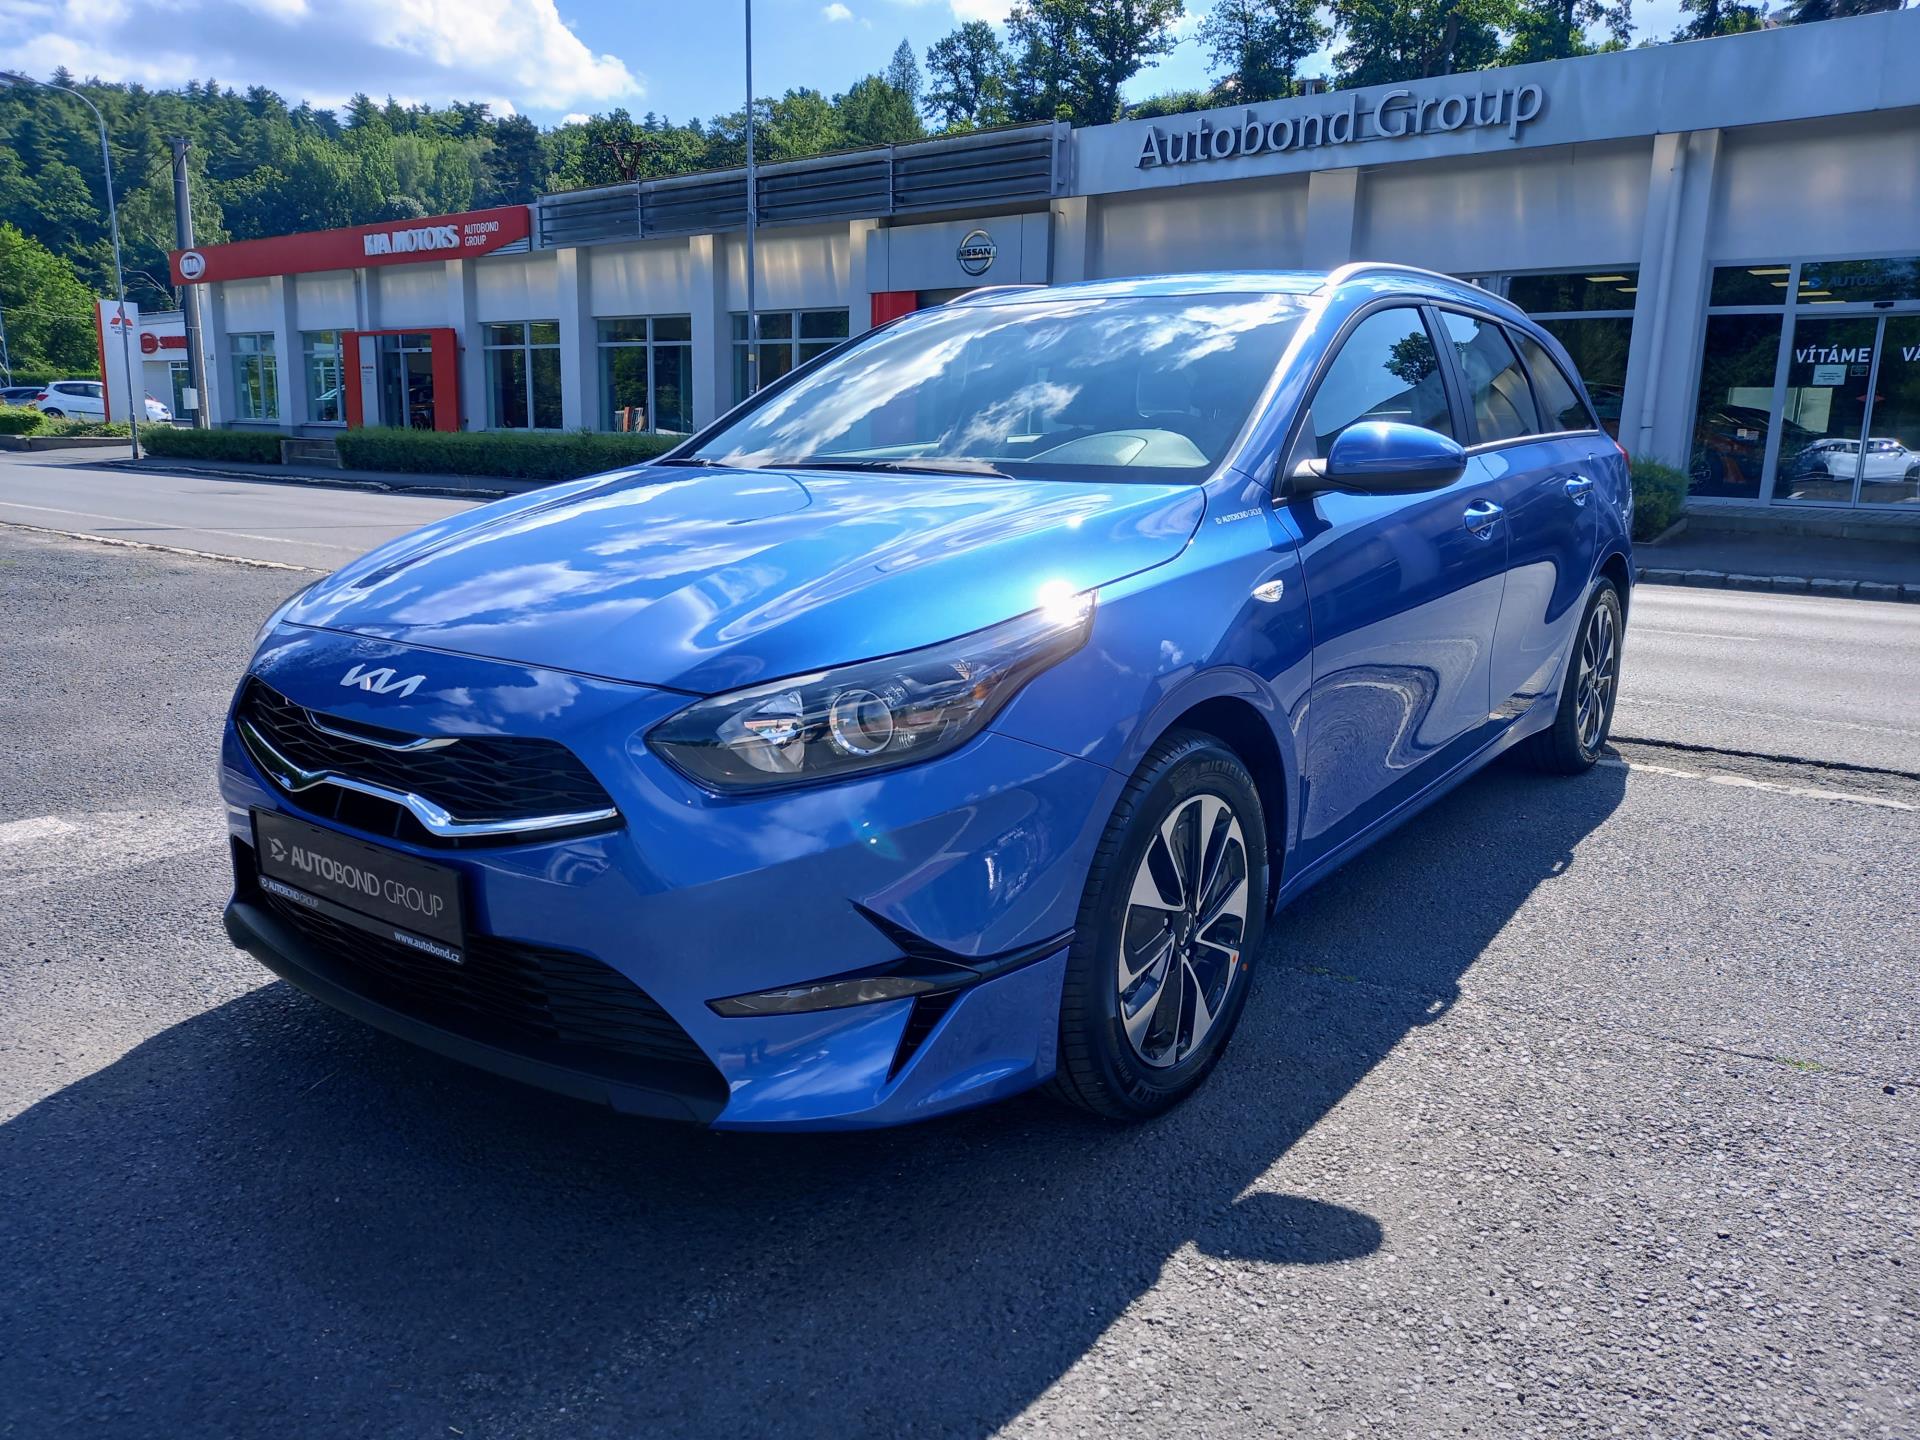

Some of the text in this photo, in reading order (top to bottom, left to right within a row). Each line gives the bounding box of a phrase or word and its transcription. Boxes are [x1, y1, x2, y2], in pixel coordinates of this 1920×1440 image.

[1134, 82, 1543, 169] Autobond Group
[464, 221, 499, 235] AUTOBOND
[363, 224, 461, 256] KIA MOTORS
[464, 235, 487, 247] GROUP
[959, 247, 992, 257] NISSAN
[1795, 344, 1872, 364] VÍTÁME
[268, 881, 299, 901] AUTOBOND
[291, 845, 443, 918] AUTOBOND GROUP
[394, 931, 460, 963] www.autobond.cz
